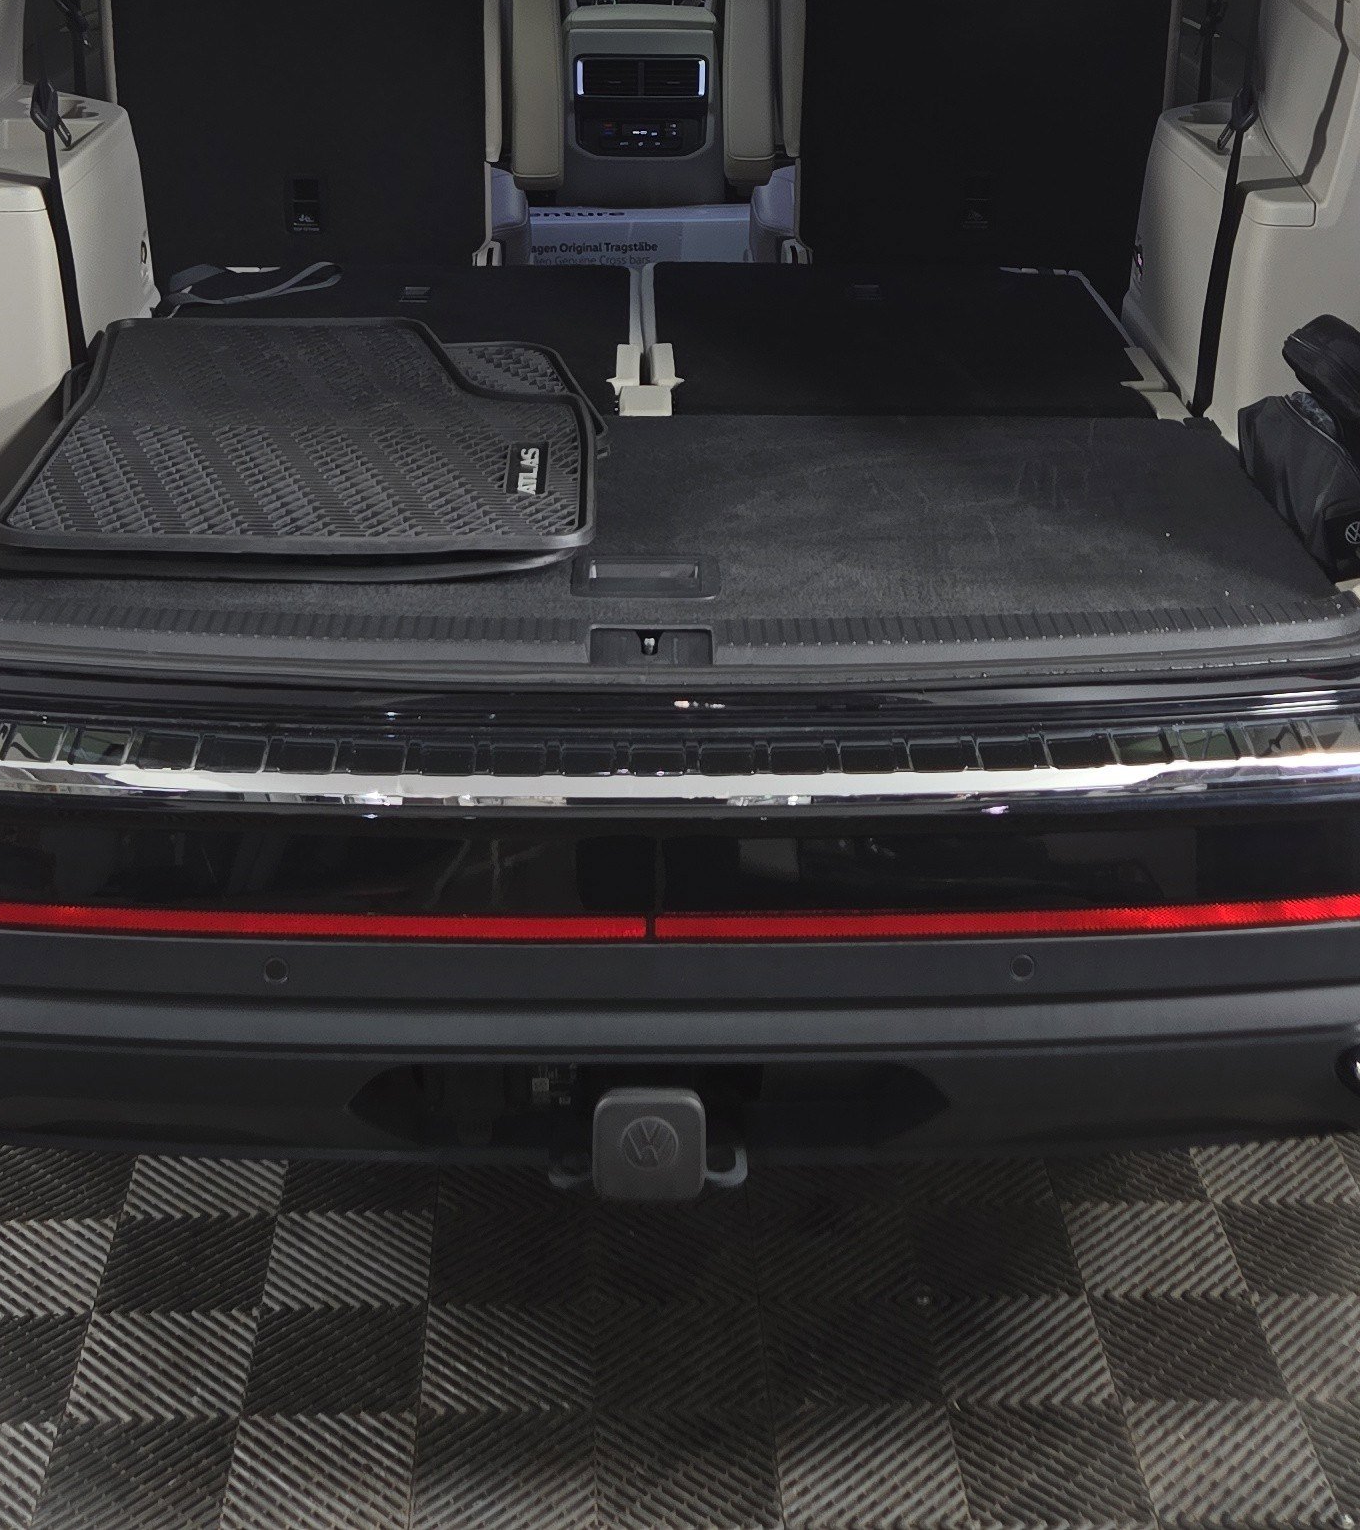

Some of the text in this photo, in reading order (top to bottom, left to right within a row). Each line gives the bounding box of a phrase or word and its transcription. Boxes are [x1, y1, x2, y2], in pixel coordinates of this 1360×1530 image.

[559, 243, 602, 255] Original
[604, 242, 658, 254] Tragstäbe
[517, 447, 540, 496] ATLAS
